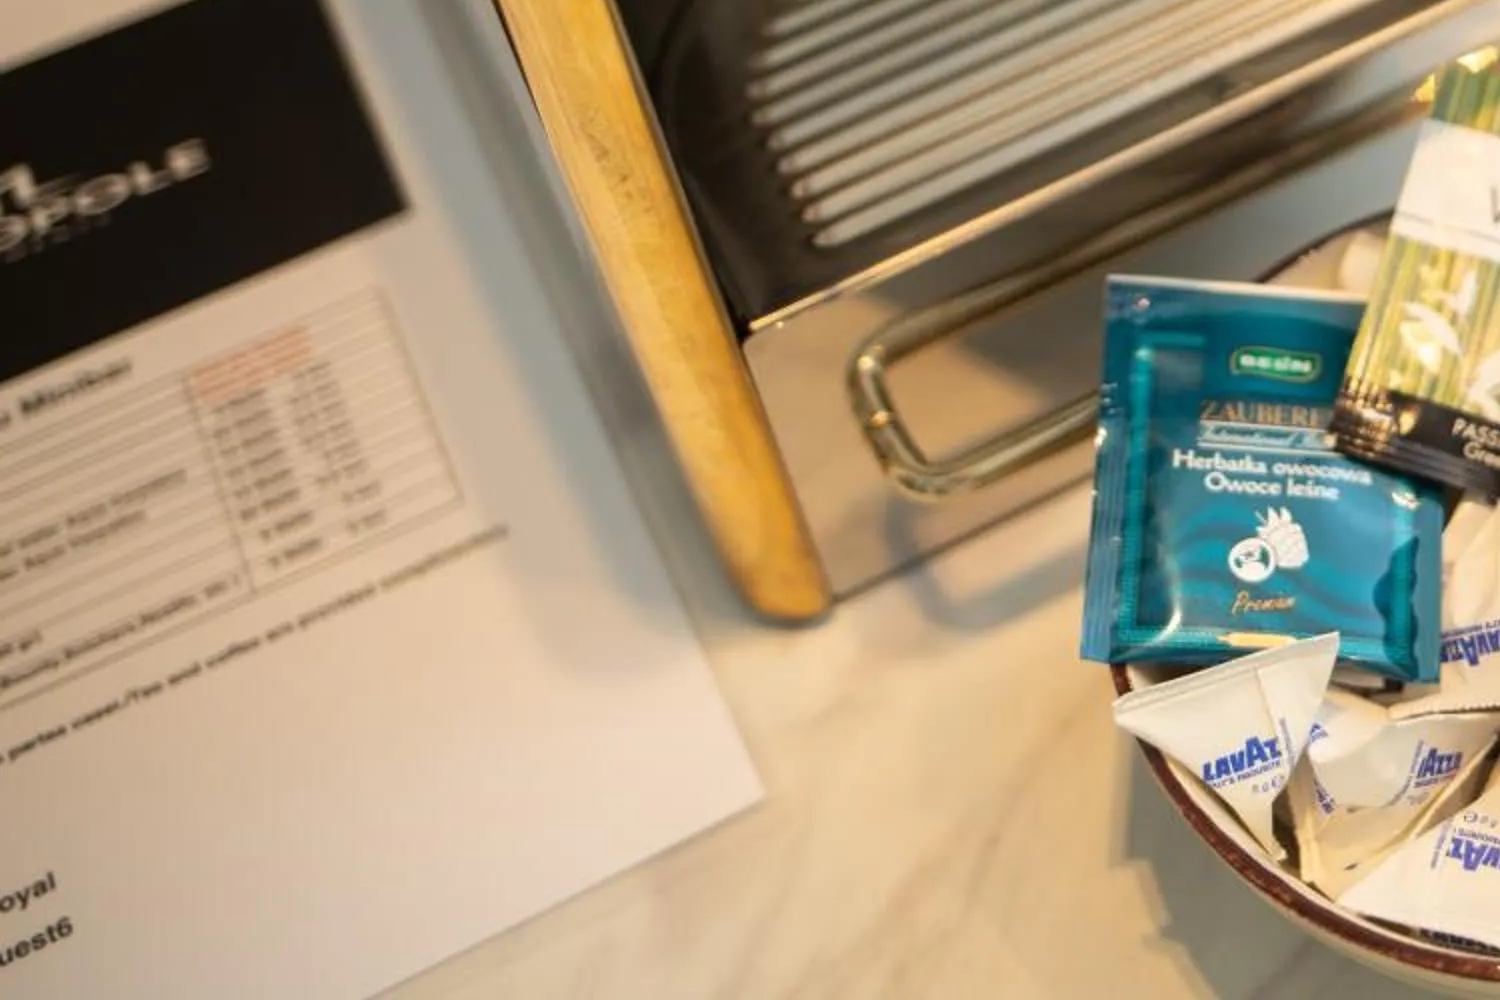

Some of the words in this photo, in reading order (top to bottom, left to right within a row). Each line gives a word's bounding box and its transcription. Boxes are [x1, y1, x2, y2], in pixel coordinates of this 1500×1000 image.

[1171, 448, 1268, 474] Herbatka
[1273, 459, 1373, 486] owocowa
[1204, 471, 1282, 496] Owoce
